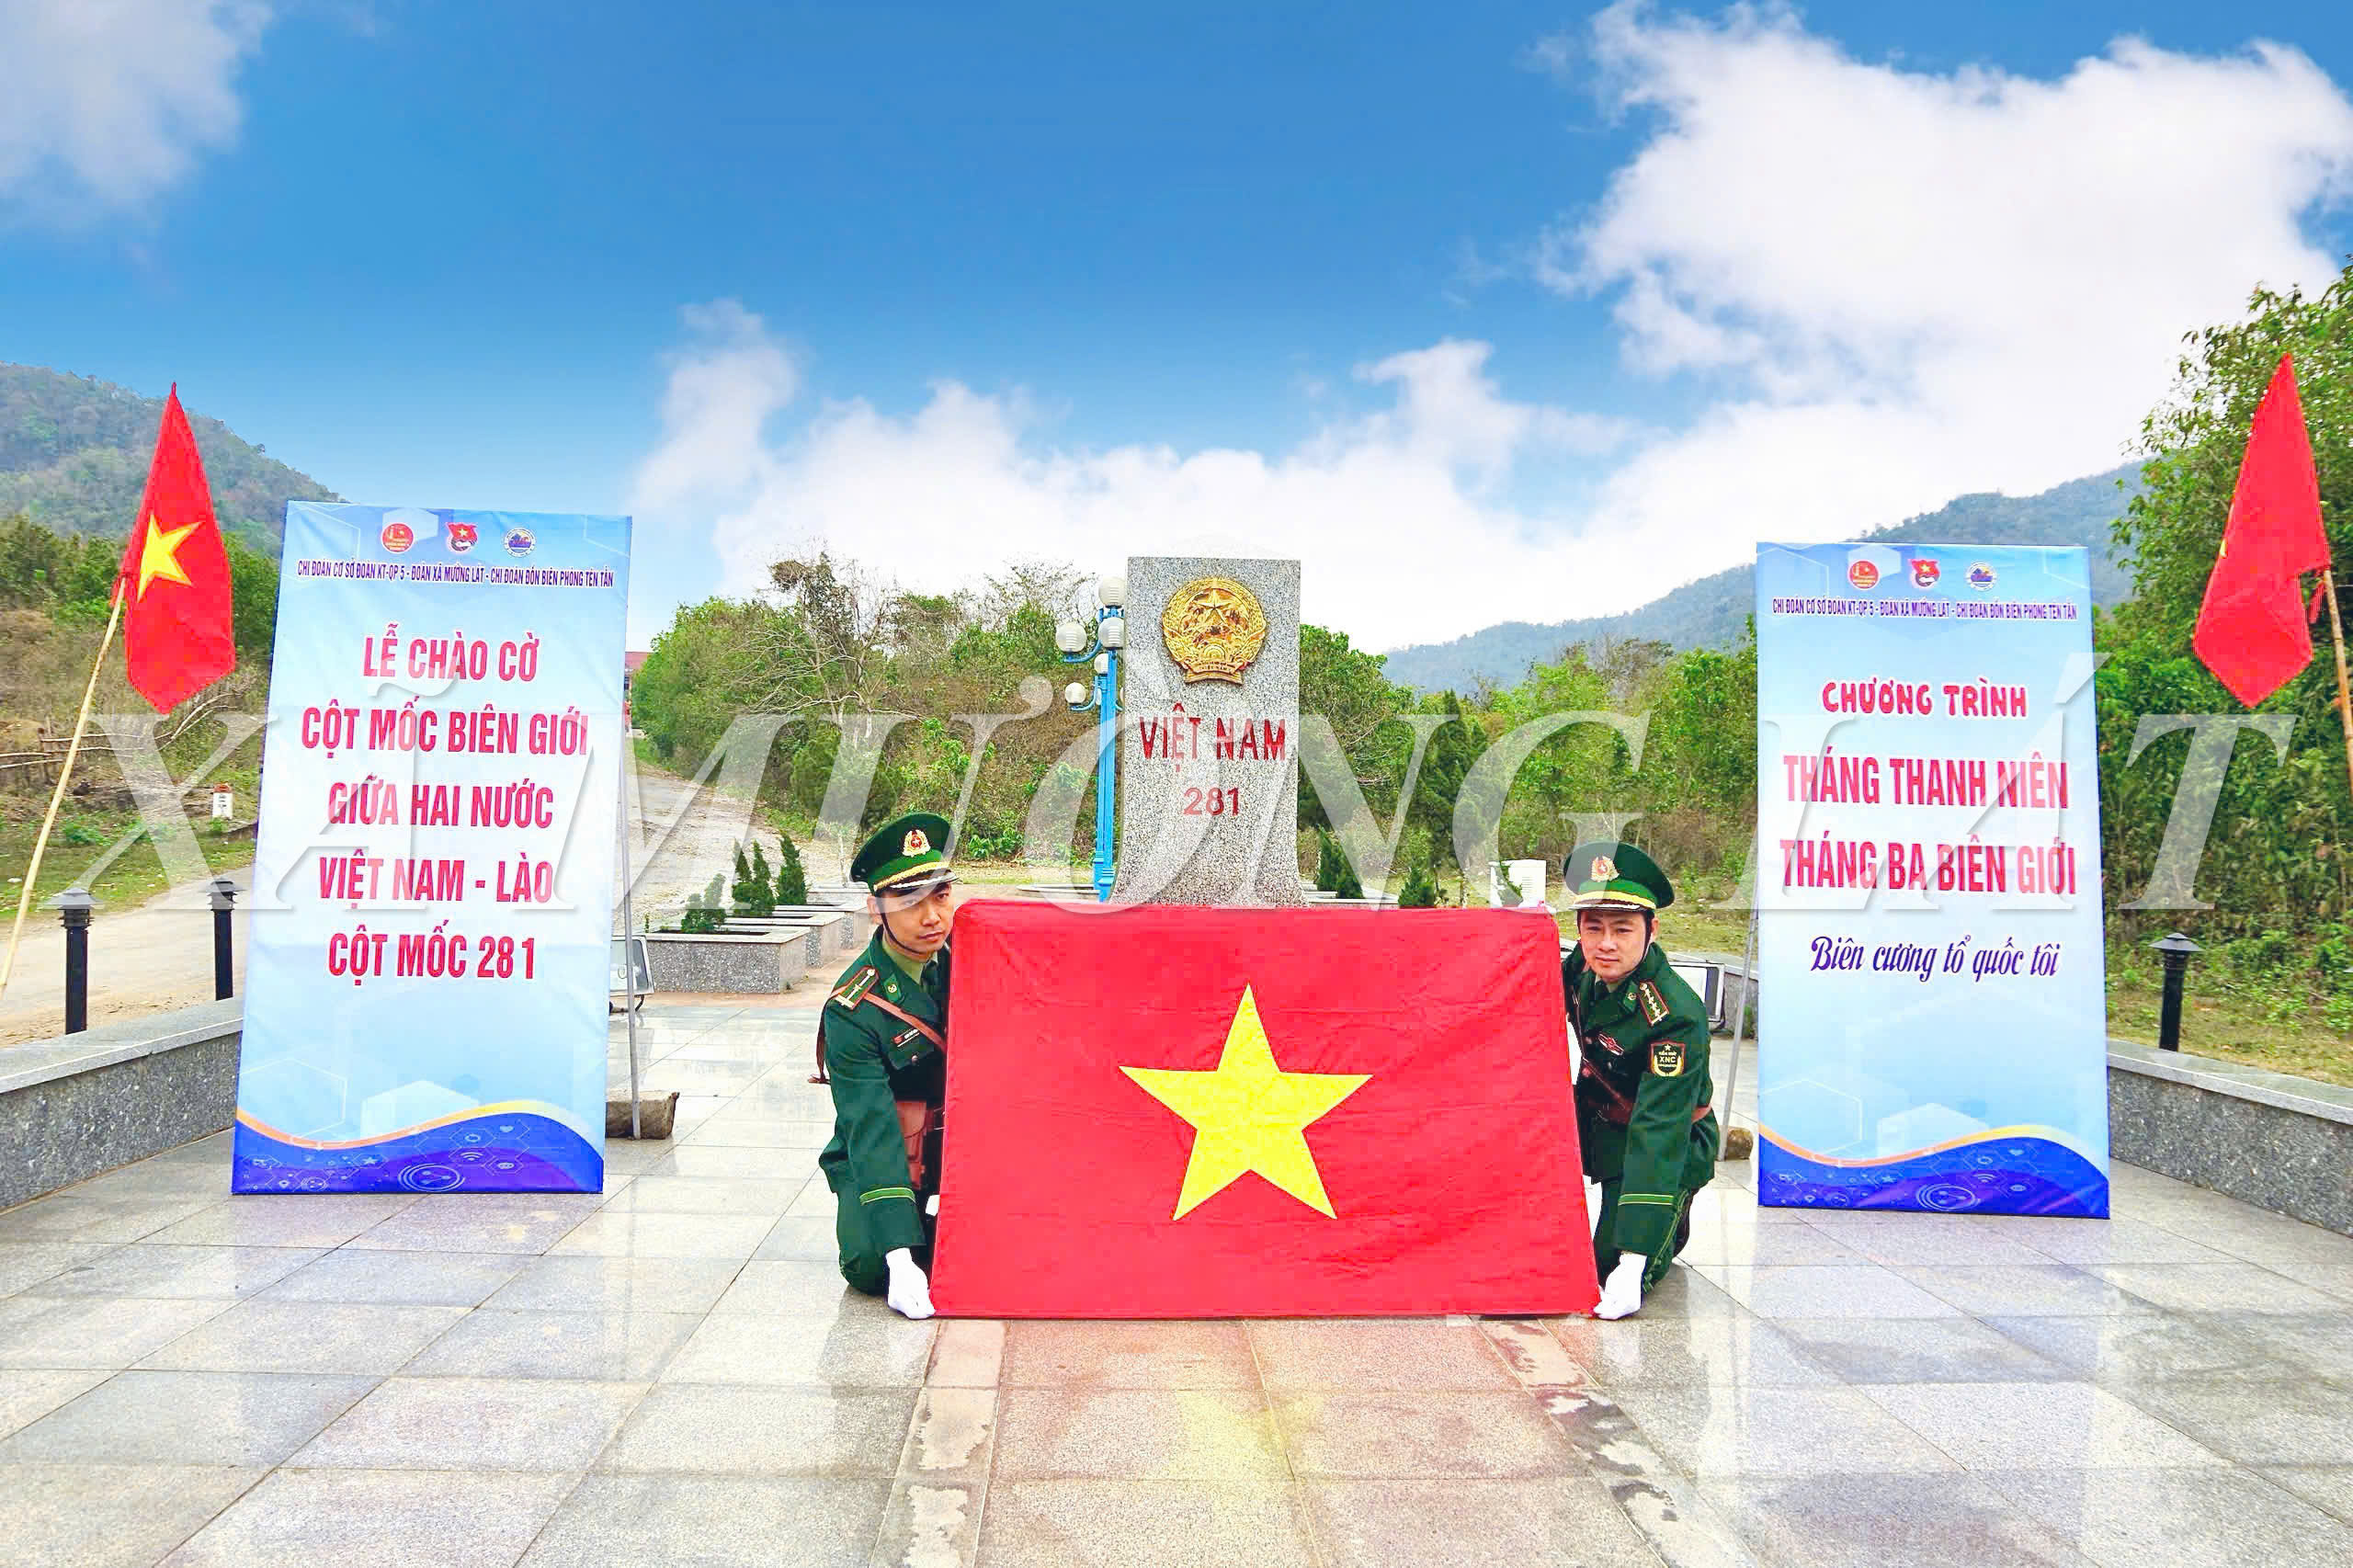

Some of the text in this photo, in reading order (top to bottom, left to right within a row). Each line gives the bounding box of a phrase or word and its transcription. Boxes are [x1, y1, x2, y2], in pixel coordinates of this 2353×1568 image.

[298, 561, 310, 575] CHI
[312, 559, 331, 576] ĐOÀN
[334, 562, 344, 577] CƠ
[345, 557, 355, 578] SỞ
[377, 563, 398, 581] KT-QP
[400, 565, 405, 580] 5
[412, 562, 431, 581] ĐOÀN
[432, 562, 441, 581] XÃ
[444, 562, 470, 582] MƯỜNG
[491, 567, 502, 584] CHI
[541, 567, 558, 585] BIÊN
[1772, 598, 1784, 613] CHI
[1806, 598, 1815, 614] CƠ
[1870, 601, 1874, 616] 5
[1956, 602, 1968, 619] CHI
[363, 623, 540, 682] LỄ CHÀO CỜ
[301, 695, 589, 758] CỘT MỐC BIÊN GIỚI
[1822, 677, 2028, 717] CHƯƠNG TRÌNH
[1139, 701, 1286, 772] VIỆT NAM
[328, 772, 553, 829] GIỮA HAI NƯỚC
[1183, 787, 1239, 816] 281
[1783, 746, 2069, 809] THÁNG THANH NIÊN
[319, 848, 383, 909] VIỆT
[392, 859, 465, 902] NAM
[496, 852, 552, 903] LÀO
[1779, 831, 1877, 889] THÁNG
[1888, 842, 1927, 891] BA
[1937, 834, 2006, 893] BIÊN
[328, 919, 535, 985] CỘT MỐC 281
[1810, 935, 2061, 983] Biên cương tổ quốc tôi
